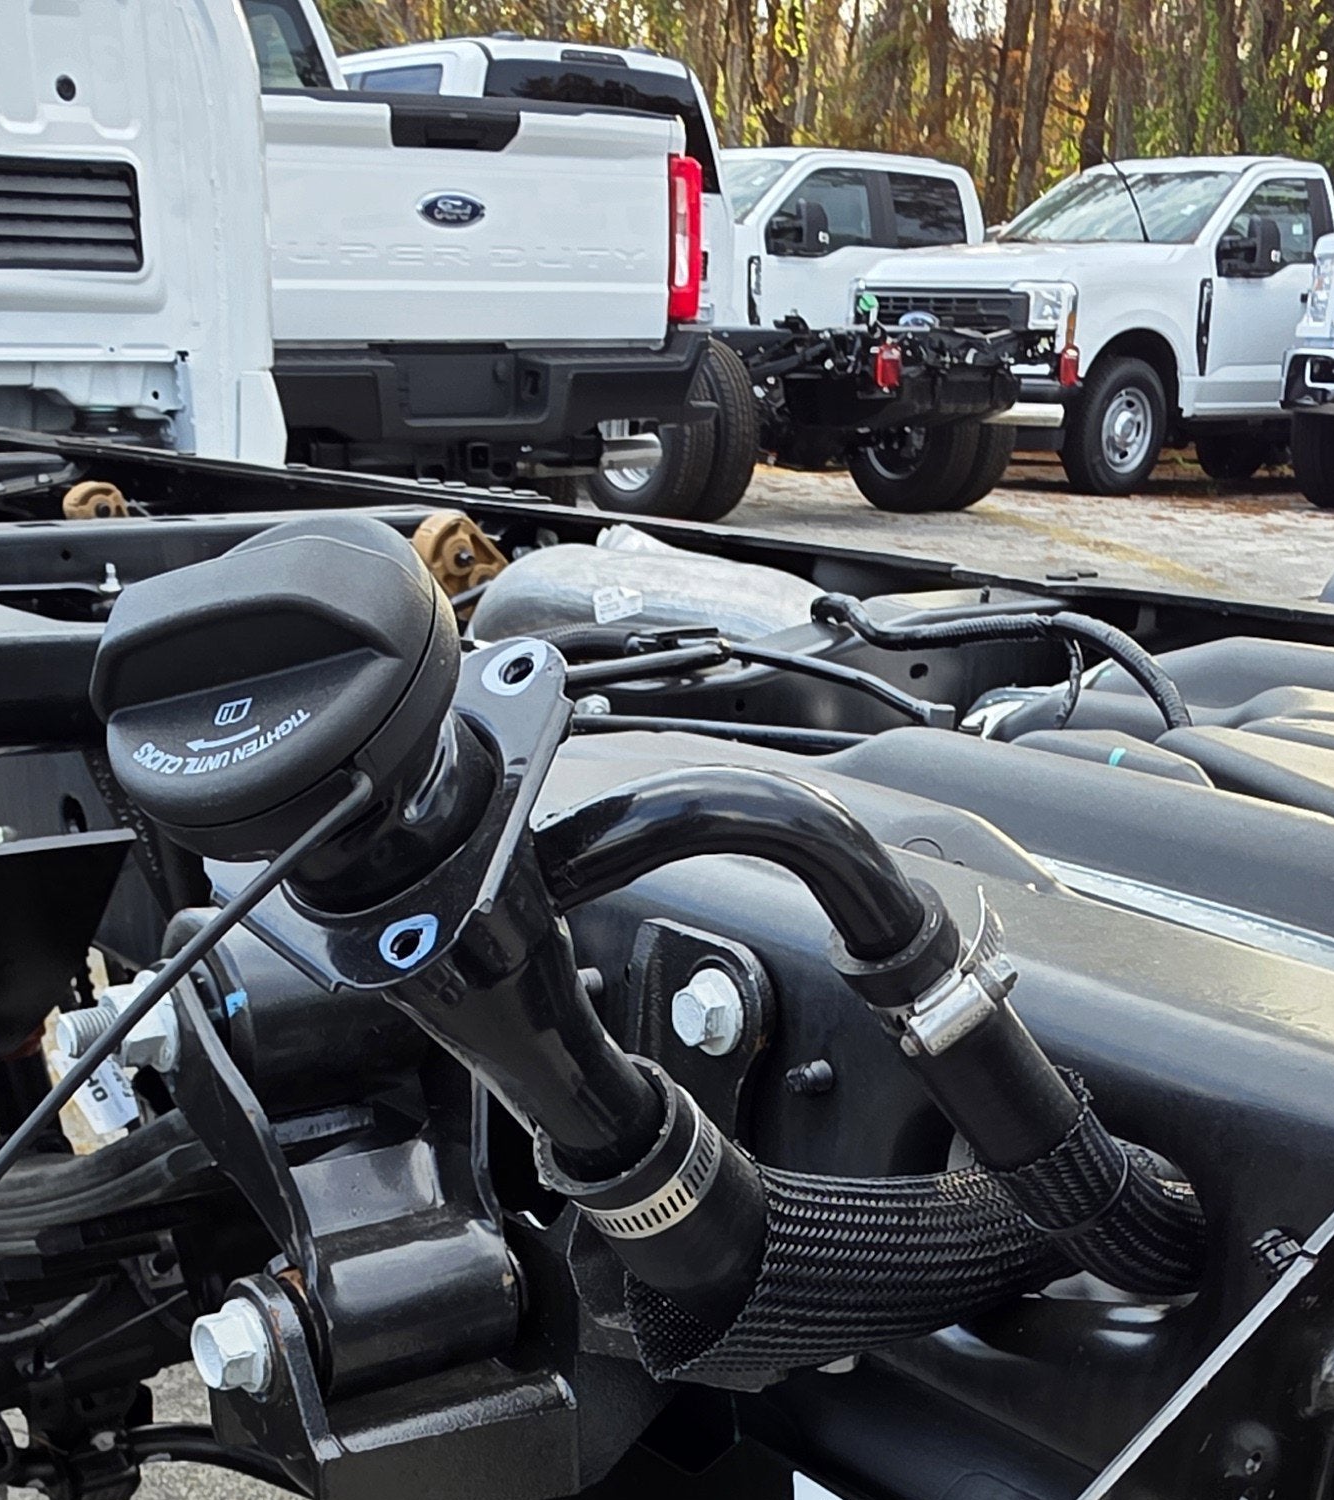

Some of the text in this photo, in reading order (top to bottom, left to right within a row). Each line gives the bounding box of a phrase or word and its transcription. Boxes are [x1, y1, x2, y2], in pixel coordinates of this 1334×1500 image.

[271, 241, 645, 270] UPER DUTY
[133, 709, 311, 775] TIGHTEN UNTIL CLICKS
